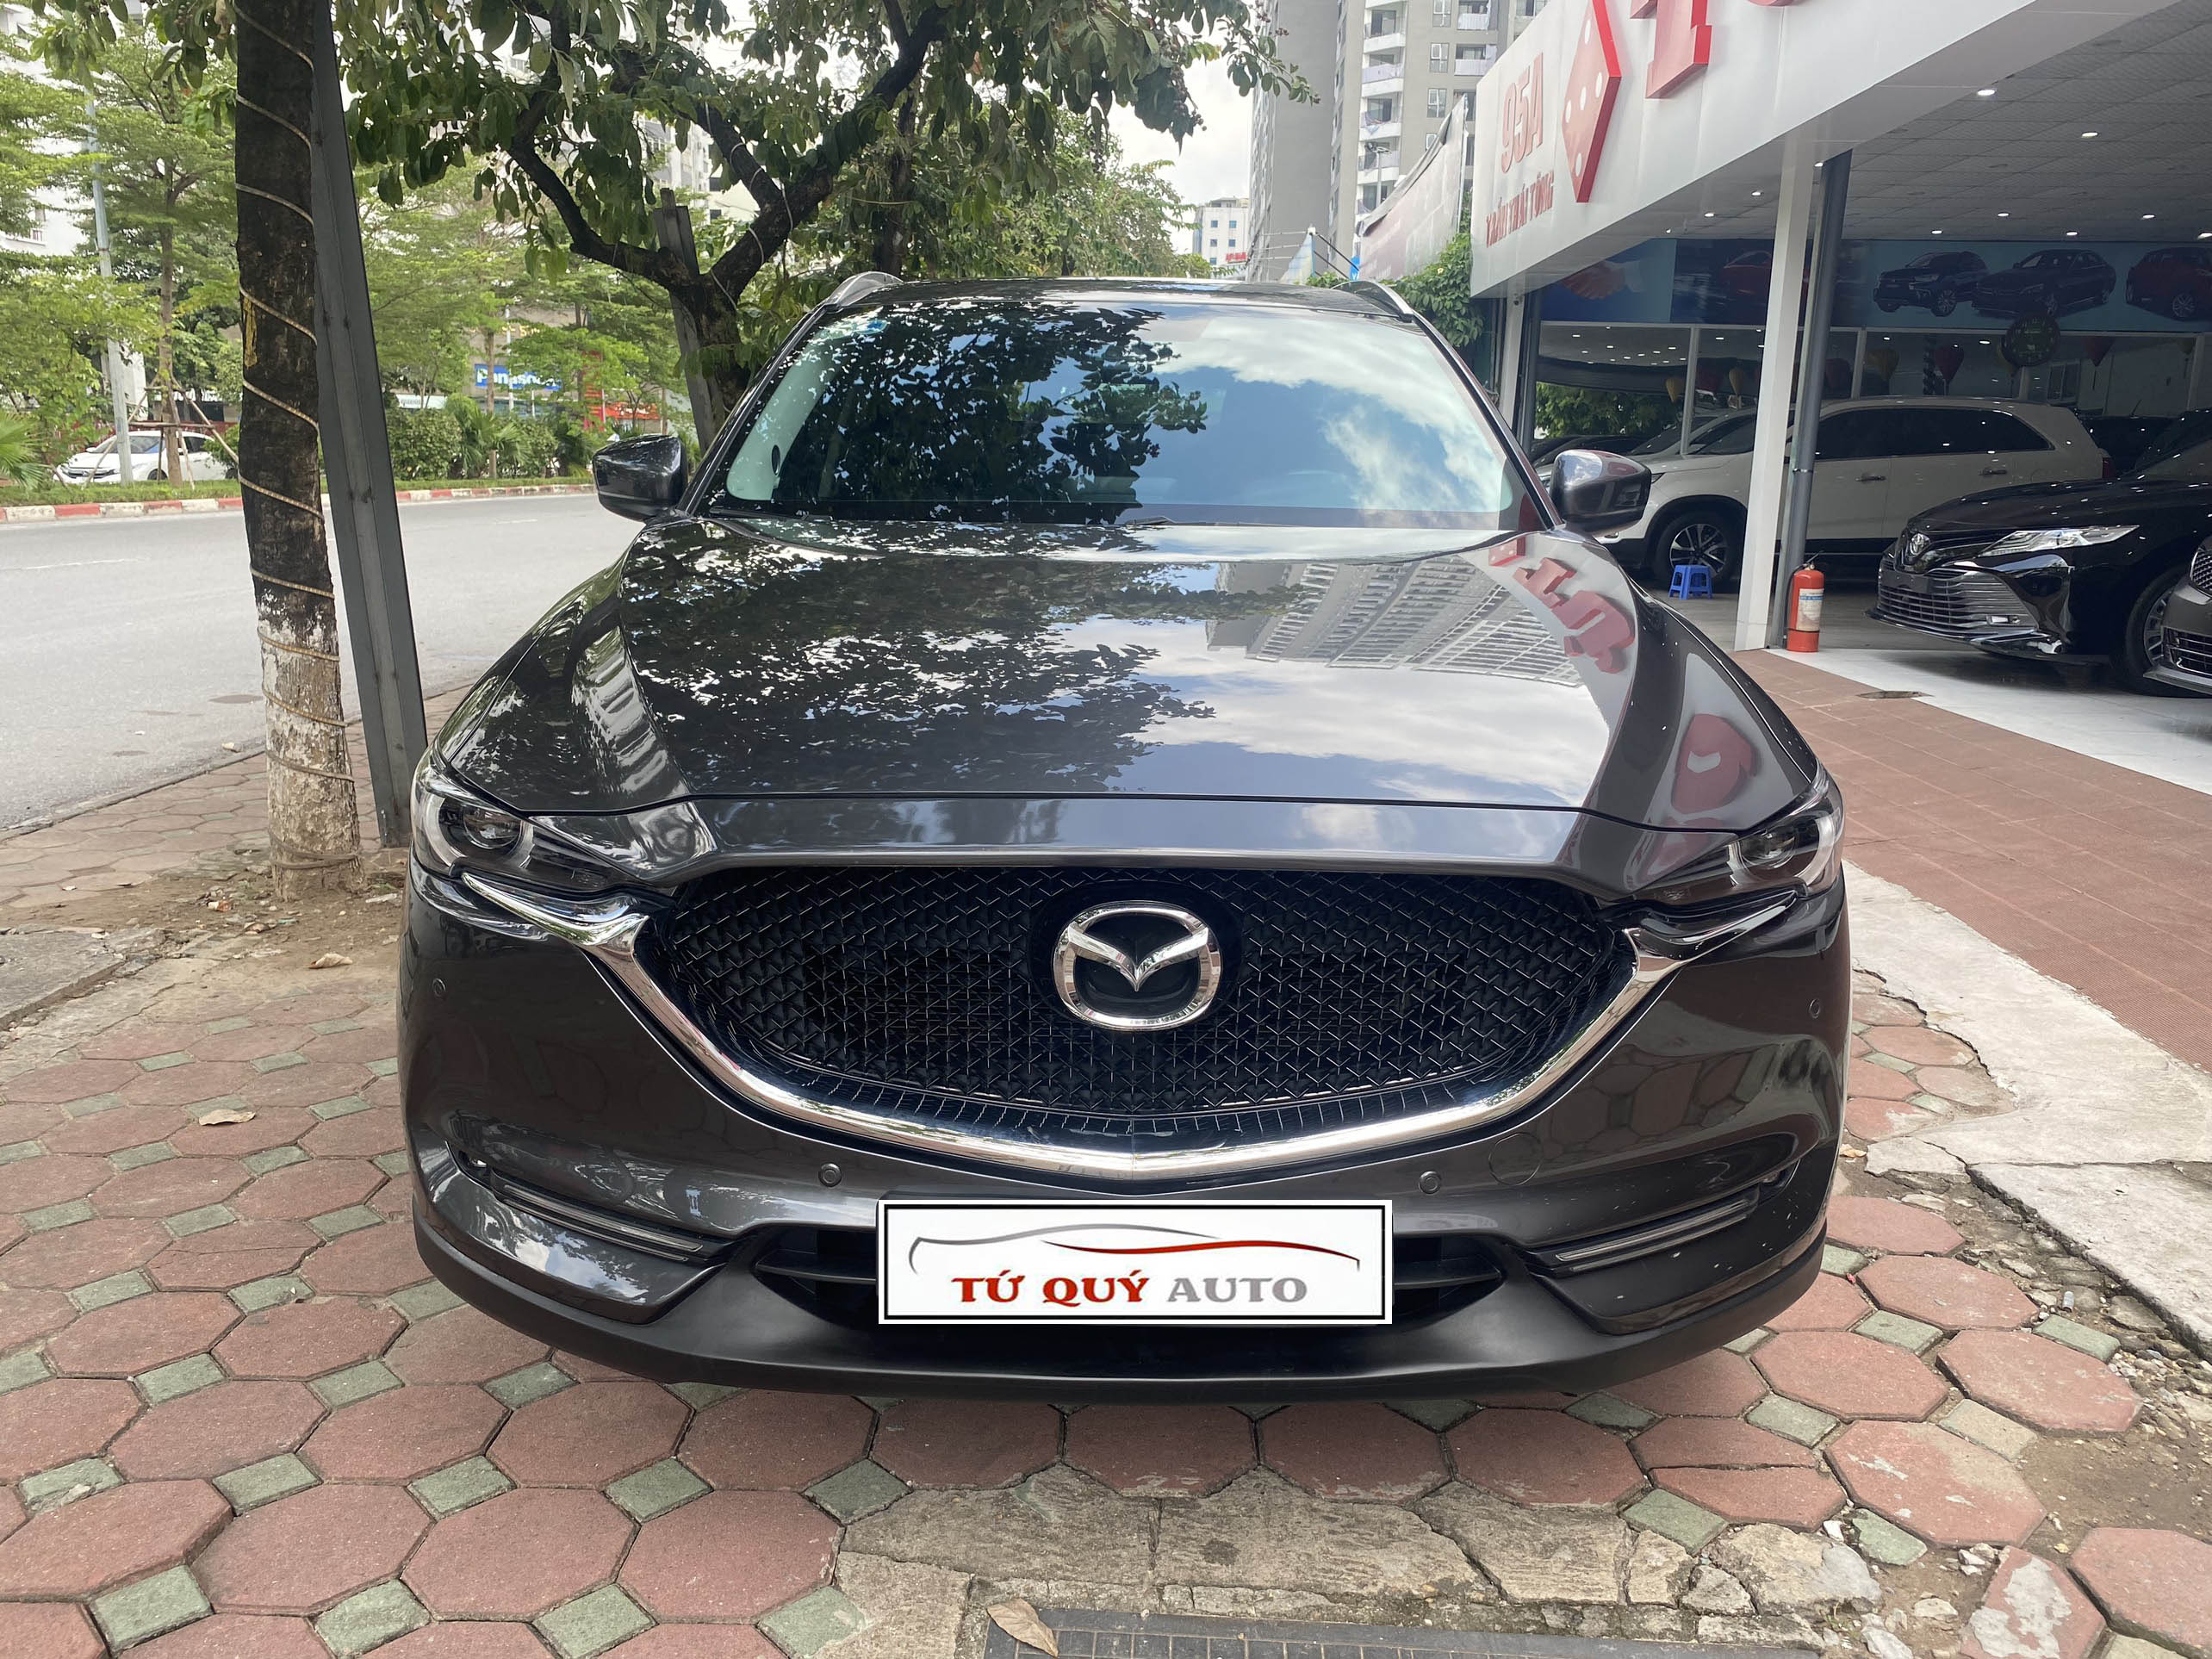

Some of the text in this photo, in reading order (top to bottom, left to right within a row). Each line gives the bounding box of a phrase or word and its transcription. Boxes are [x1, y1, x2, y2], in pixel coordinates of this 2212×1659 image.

[1501, 52, 1544, 173] 95A
[1509, 183, 1529, 234] THÁI
[1530, 169, 1554, 221] TÔNG
